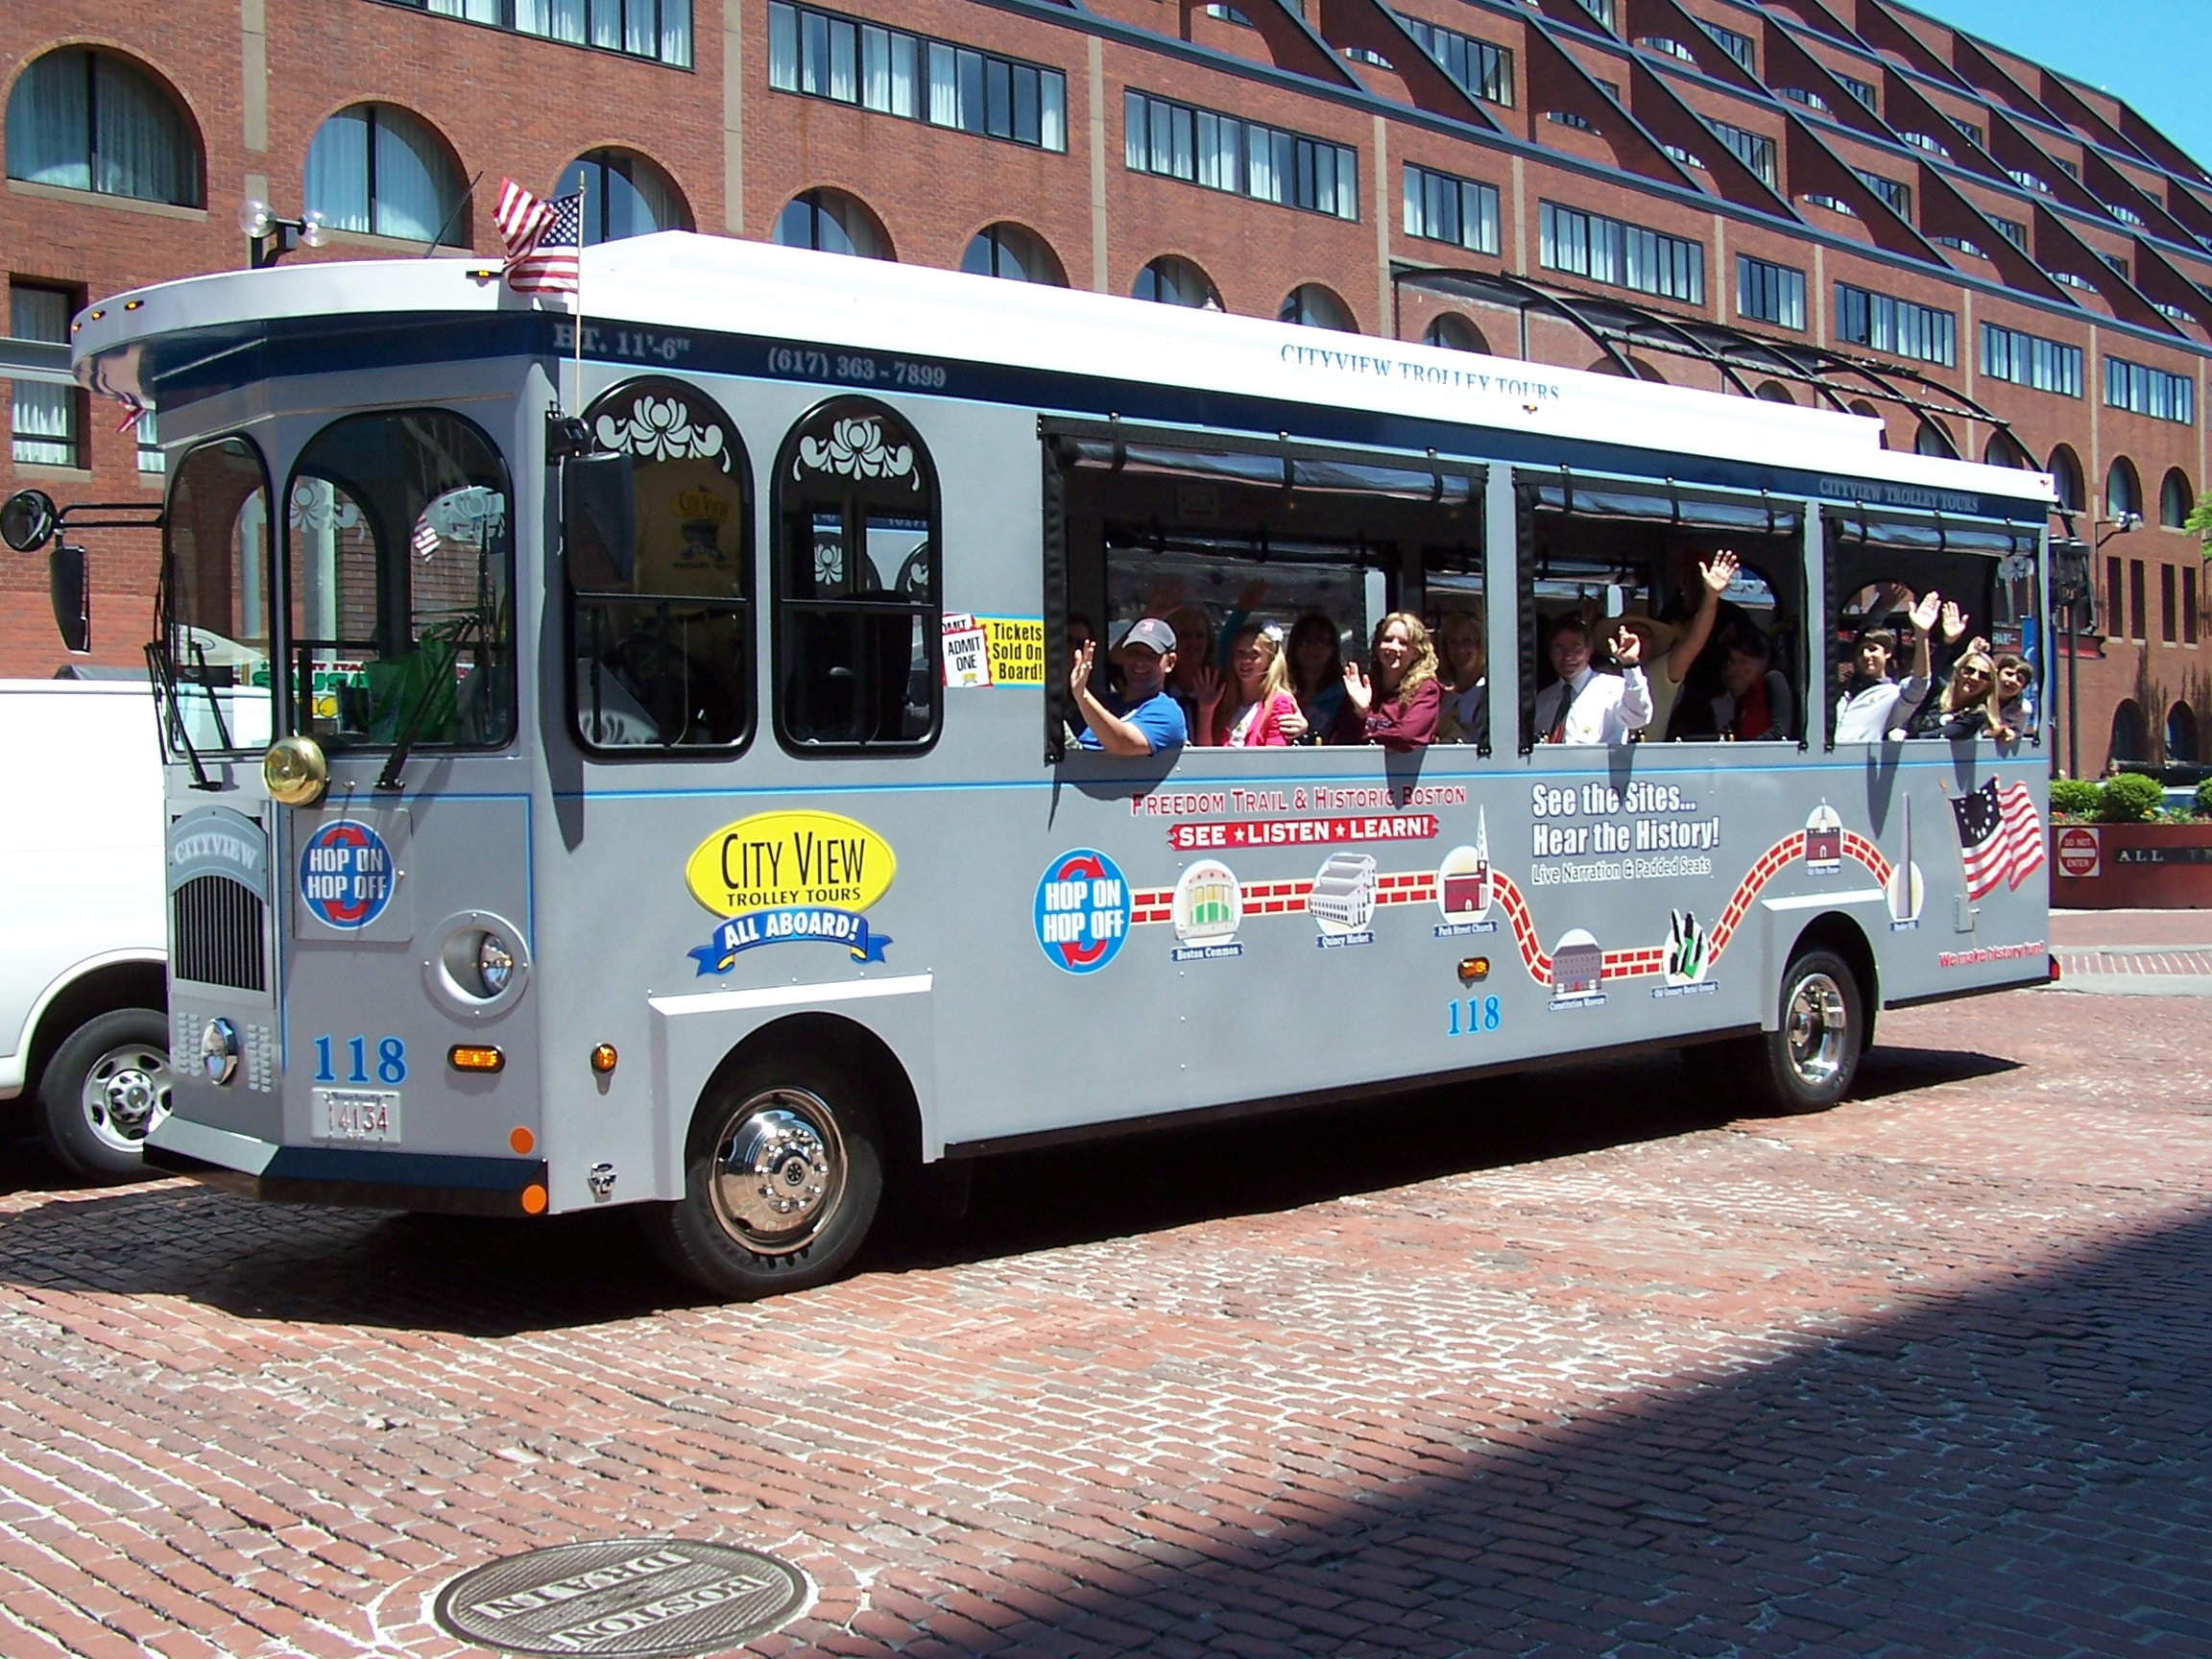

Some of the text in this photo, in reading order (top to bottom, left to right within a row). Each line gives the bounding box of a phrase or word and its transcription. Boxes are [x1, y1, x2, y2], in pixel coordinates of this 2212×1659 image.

[553, 323, 608, 353] HT.
[768, 347, 829, 378] (617)
[836, 355, 876, 381] 363
[894, 361, 947, 389] 7899
[1281, 344, 1392, 377] CITYVIEW
[1495, 377, 1560, 401] TOURS
[1819, 479, 1979, 513] CITYVIEW TROLLEY TOURS
[948, 637, 980, 657] ADMIT
[993, 622, 1042, 641] Tickets
[956, 654, 977, 671] ONE
[993, 642, 1042, 660] Sold On
[999, 662, 1043, 680] Board!
[1131, 785, 1466, 816] FREEDOM TRAIL & HISTORIC BOSTON
[1532, 781, 1697, 817] See the Sites...
[1178, 817, 1430, 846] SEE LISTEN LEARN!
[1532, 816, 1720, 857] Hear the History!
[174, 831, 258, 870] CITYVIEW
[309, 848, 384, 873] HOP ON
[721, 831, 865, 889] CITY VIEW
[2066, 858, 2090, 867] ENTER
[2118, 849, 2163, 862] ALL
[1531, 854, 1711, 885] Live Narration & Padded Seats
[307, 875, 386, 900] HOP OFF
[726, 887, 861, 907] TROLLEY TOURS
[1045, 878, 1120, 911] HOP ON
[724, 911, 860, 950] ALL ABOARD!
[1043, 909, 1124, 943] HOP OFF
[1176, 949, 1204, 960] Boston
[1938, 939, 2044, 968] We make history fun!
[1447, 994, 1501, 1037] 118
[314, 1034, 407, 1085] 118
[328, 1100, 389, 1134] 14134
[485, 1550, 682, 1619] DRAIN
[561, 1575, 760, 1647] BOSTON
